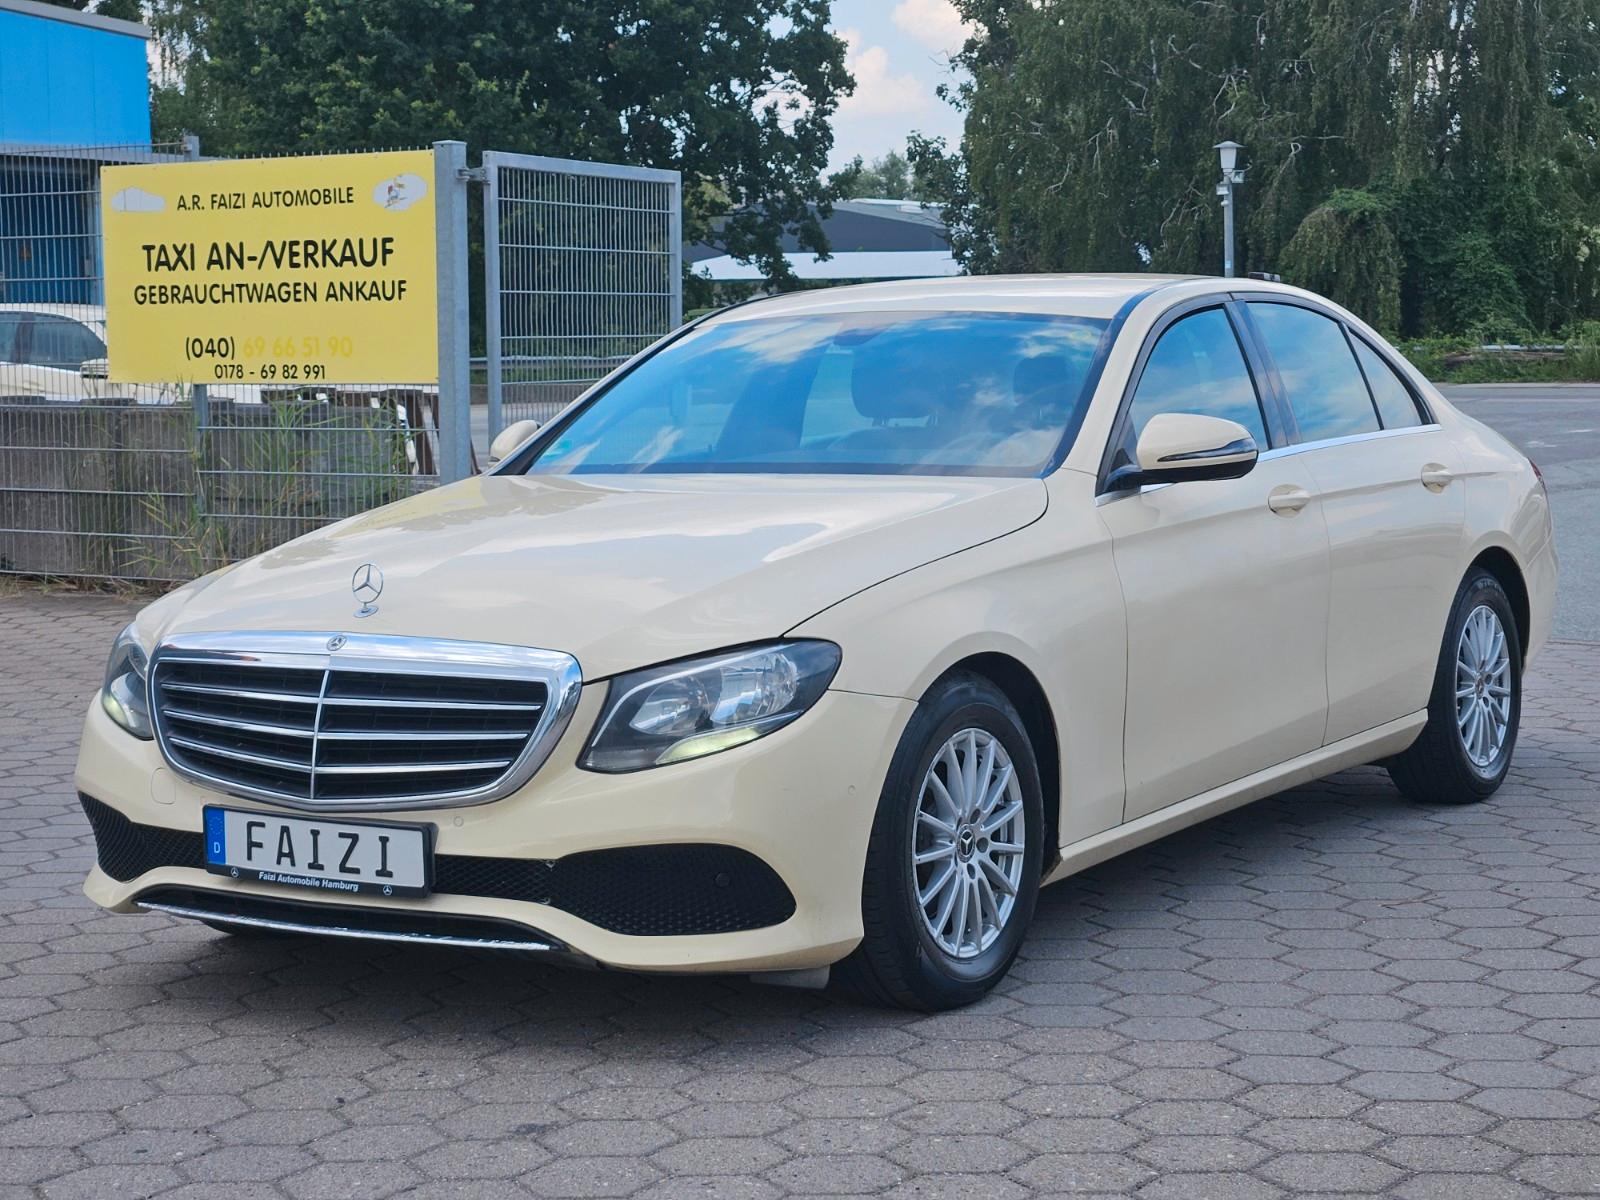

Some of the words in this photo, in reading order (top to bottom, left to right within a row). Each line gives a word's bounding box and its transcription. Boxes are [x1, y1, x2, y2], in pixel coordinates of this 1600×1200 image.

[177, 195, 205, 211] A.R.
[211, 193, 246, 210] FAIZI
[252, 187, 354, 208] AUTOMOBILE
[142, 243, 195, 272] TAXI
[134, 282, 317, 305] GEBRAUCHTWAGEN
[325, 280, 407, 302] ANKAUF
[185, 336, 235, 360] (040)
[242, 337, 265, 358] 69
[214, 364, 244, 379] 0178
[260, 364, 277, 379] 69
[282, 364, 298, 379] 82
[303, 364, 326, 379] 991
[213, 841, 221, 854] D
[246, 821, 393, 878] FAIZI
[258, 871, 276, 882] Faizi
[277, 874, 320, 888] Automobile
[322, 880, 359, 892] Hamburg
